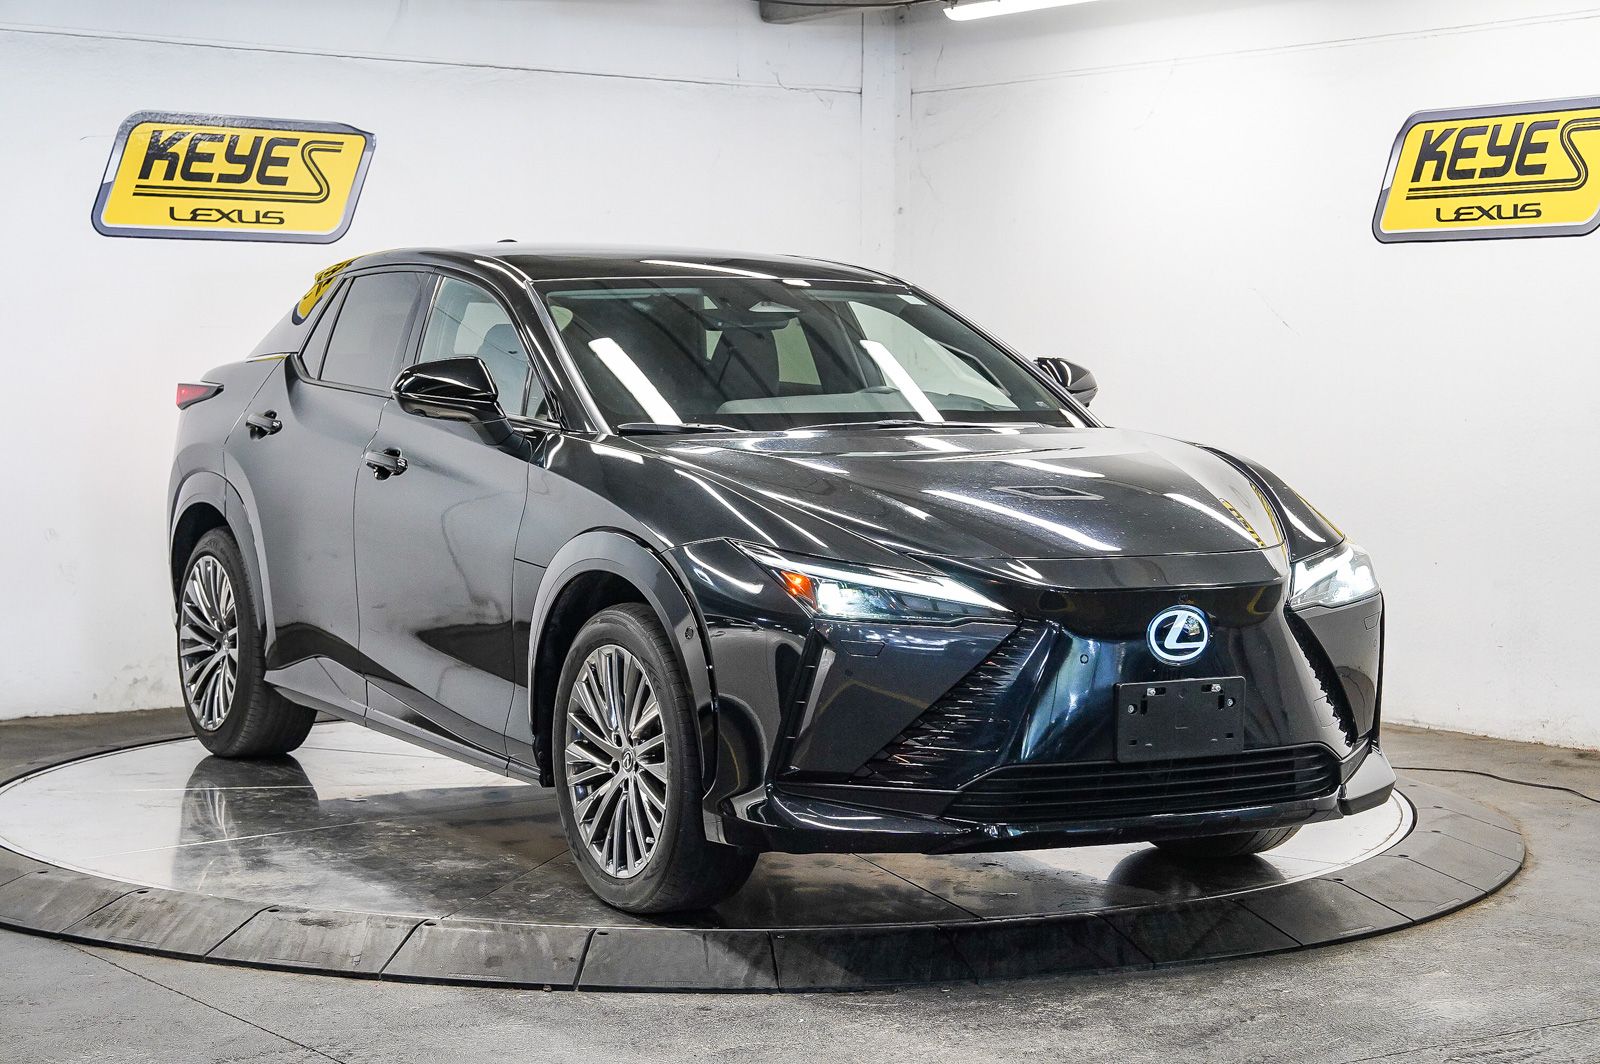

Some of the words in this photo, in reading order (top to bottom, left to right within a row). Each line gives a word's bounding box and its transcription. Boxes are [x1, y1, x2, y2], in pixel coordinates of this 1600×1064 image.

[138, 130, 344, 203] KEYES
[1411, 117, 1600, 191] KEYES
[169, 206, 285, 224] LEXUS
[1436, 203, 1542, 222] LEXUS
